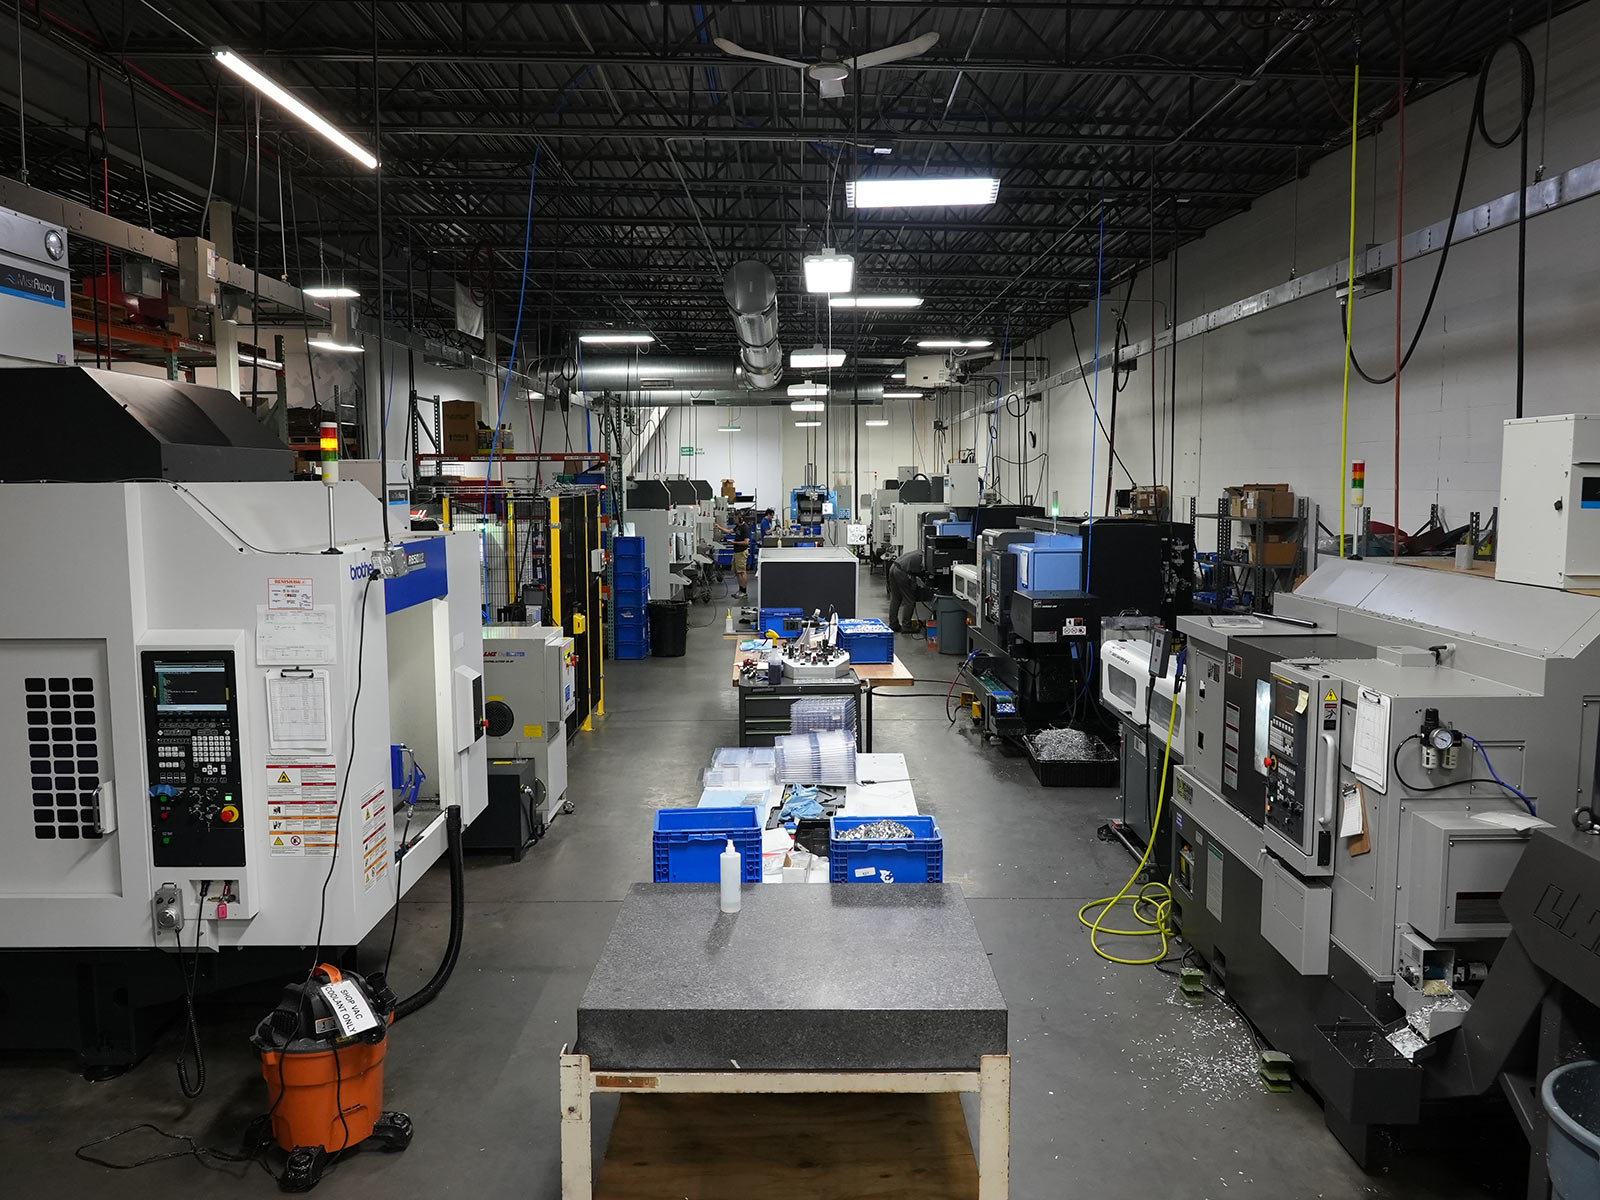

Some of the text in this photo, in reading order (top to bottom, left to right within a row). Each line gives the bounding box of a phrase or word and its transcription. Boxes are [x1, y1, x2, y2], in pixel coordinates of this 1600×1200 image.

[350, 562, 375, 581] brothe
[325, 986, 356, 1032] COOLANT ONLY
[341, 989, 363, 1020] SHOP VAC
